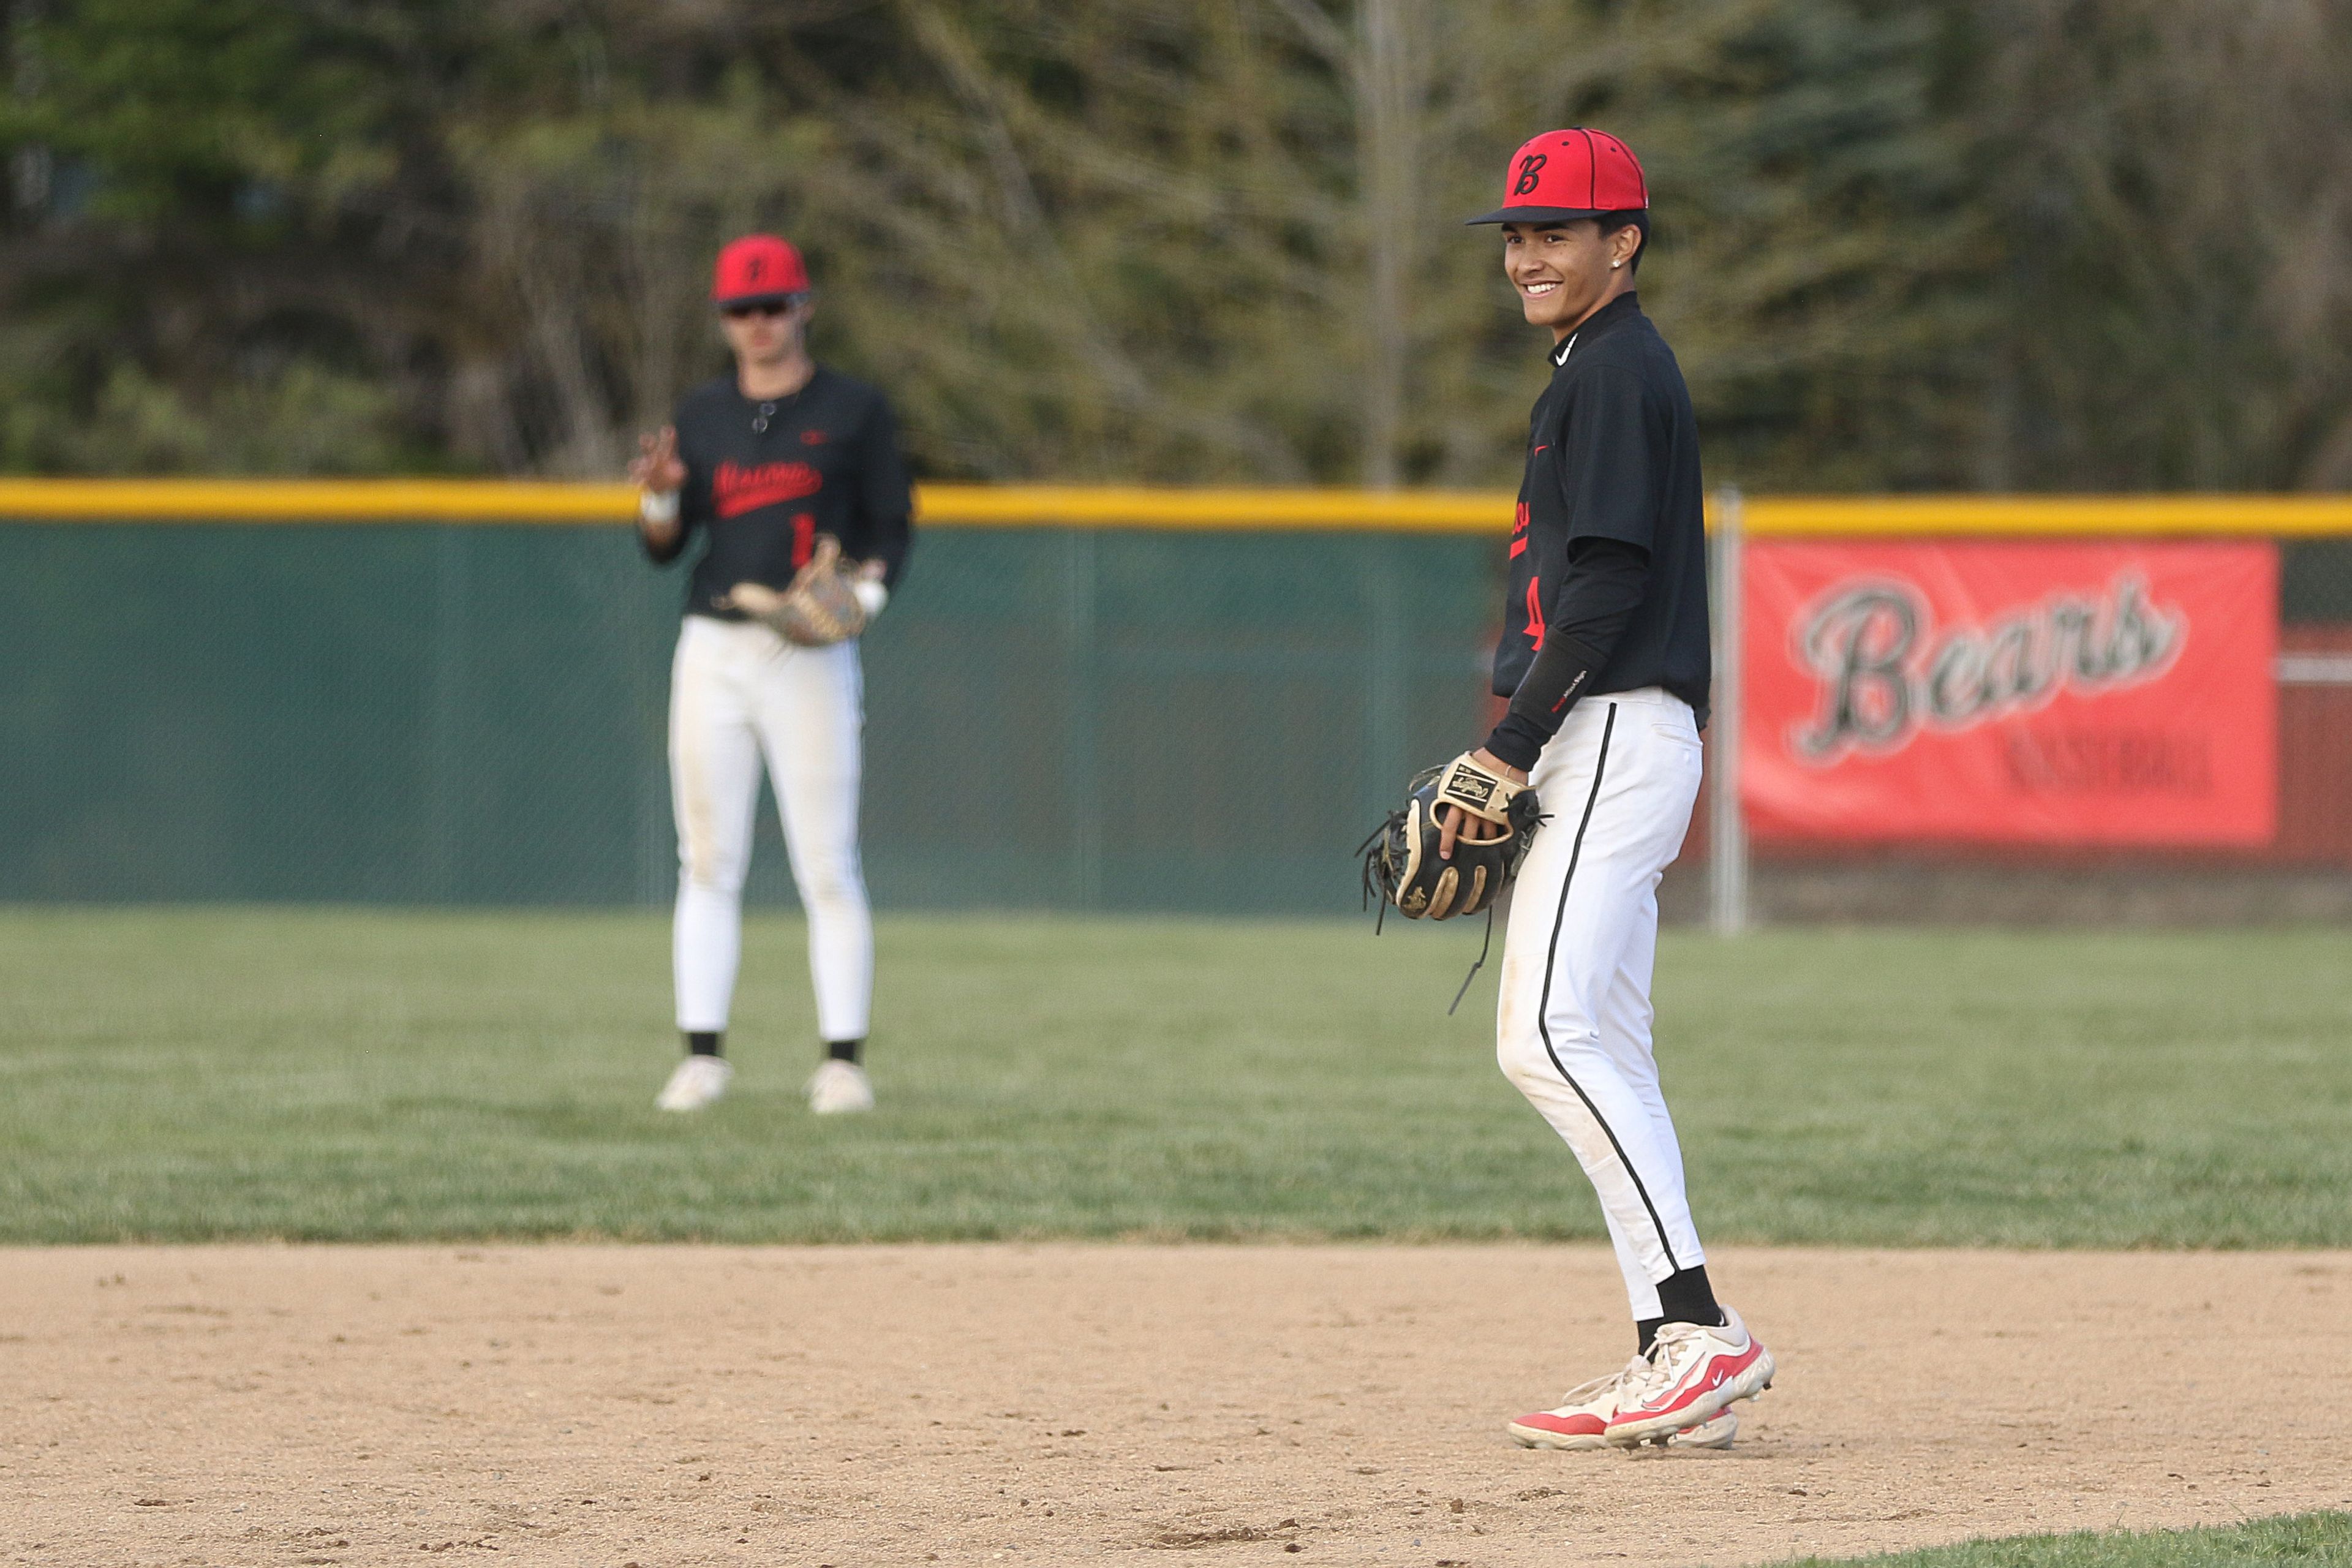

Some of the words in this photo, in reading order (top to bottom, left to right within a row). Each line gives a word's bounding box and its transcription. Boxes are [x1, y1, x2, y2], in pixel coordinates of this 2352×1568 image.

[1513, 153, 1547, 196] B
[1522, 576, 1546, 652] 4
[1790, 570, 2188, 766] Bears
